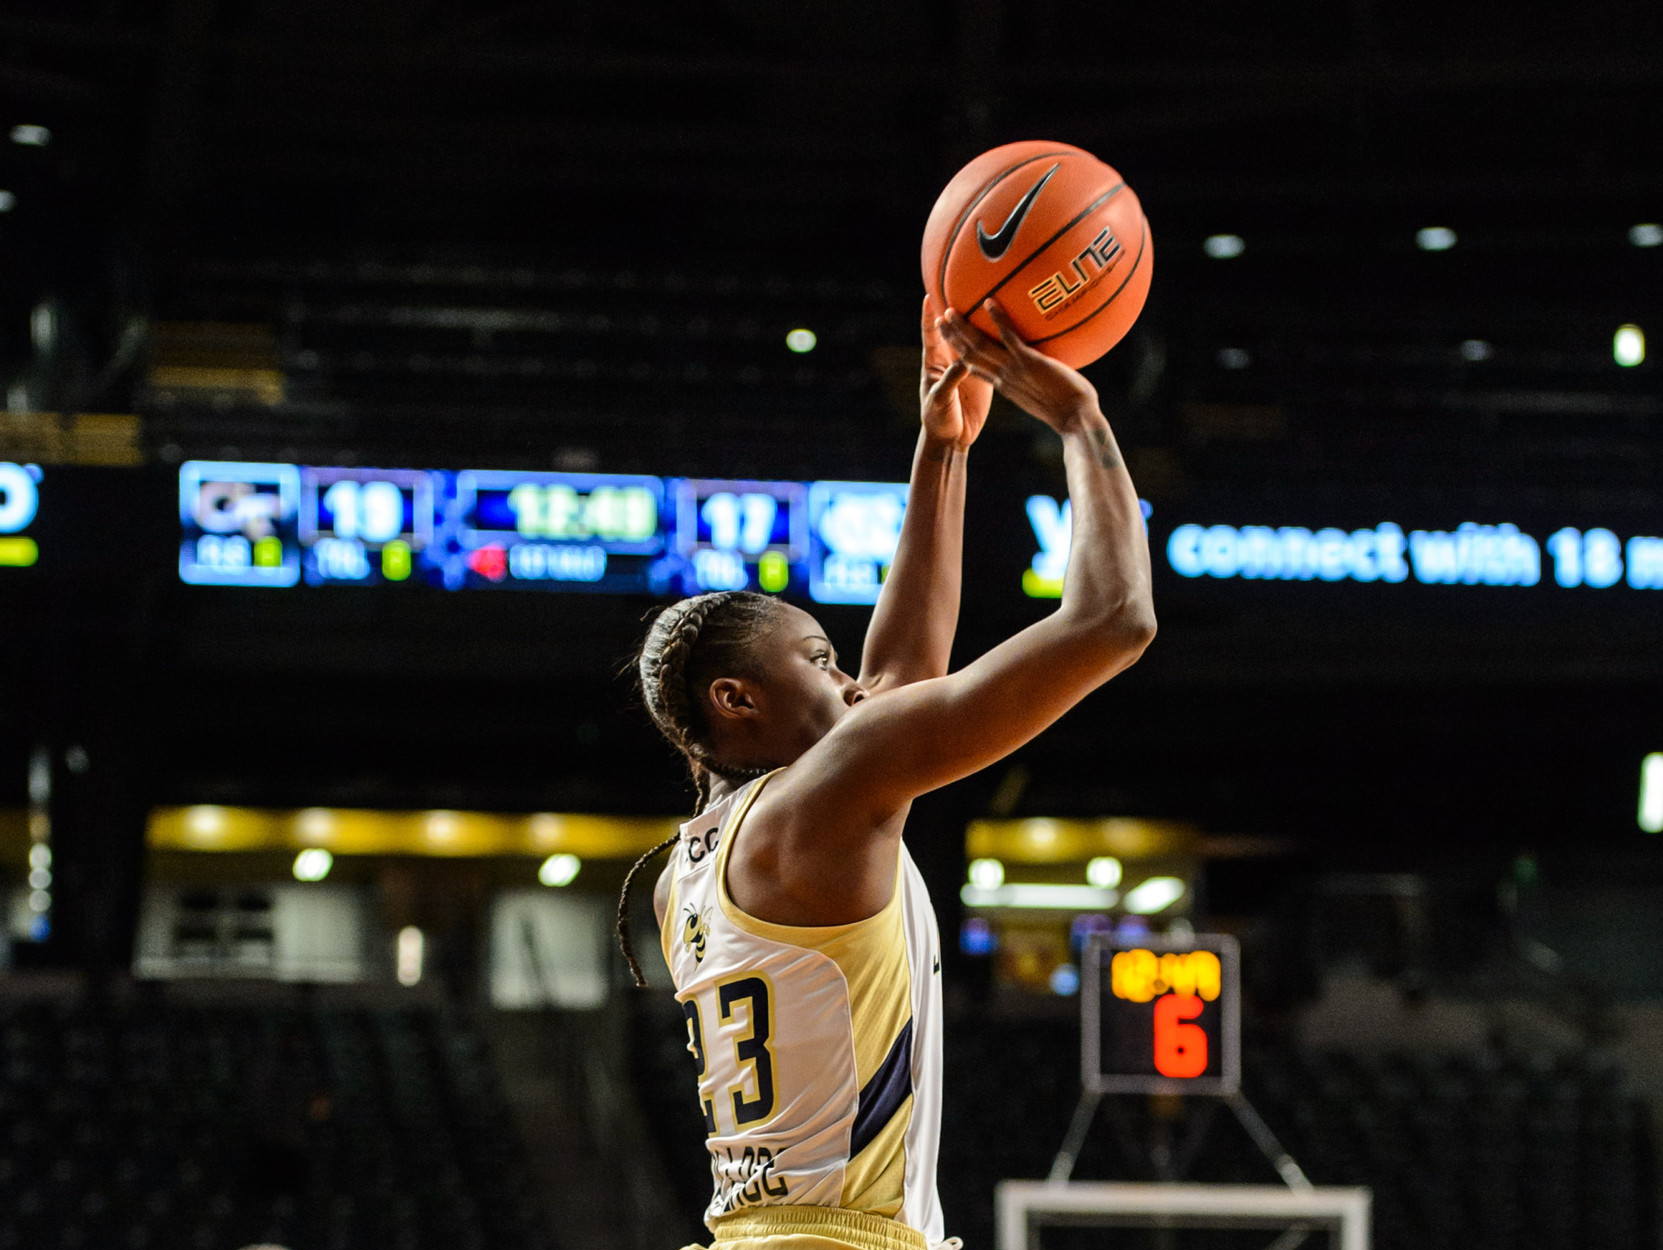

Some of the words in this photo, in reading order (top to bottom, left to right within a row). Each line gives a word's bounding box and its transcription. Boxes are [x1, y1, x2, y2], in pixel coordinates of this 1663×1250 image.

[1027, 225, 1121, 314] ELITE
[701, 492, 777, 554] 17
[1168, 523, 1408, 582] connect
[1410, 523, 1540, 586] with
[1549, 527, 1622, 588] 18
[686, 827, 720, 863] CC
[1153, 994, 1208, 1079] 6
